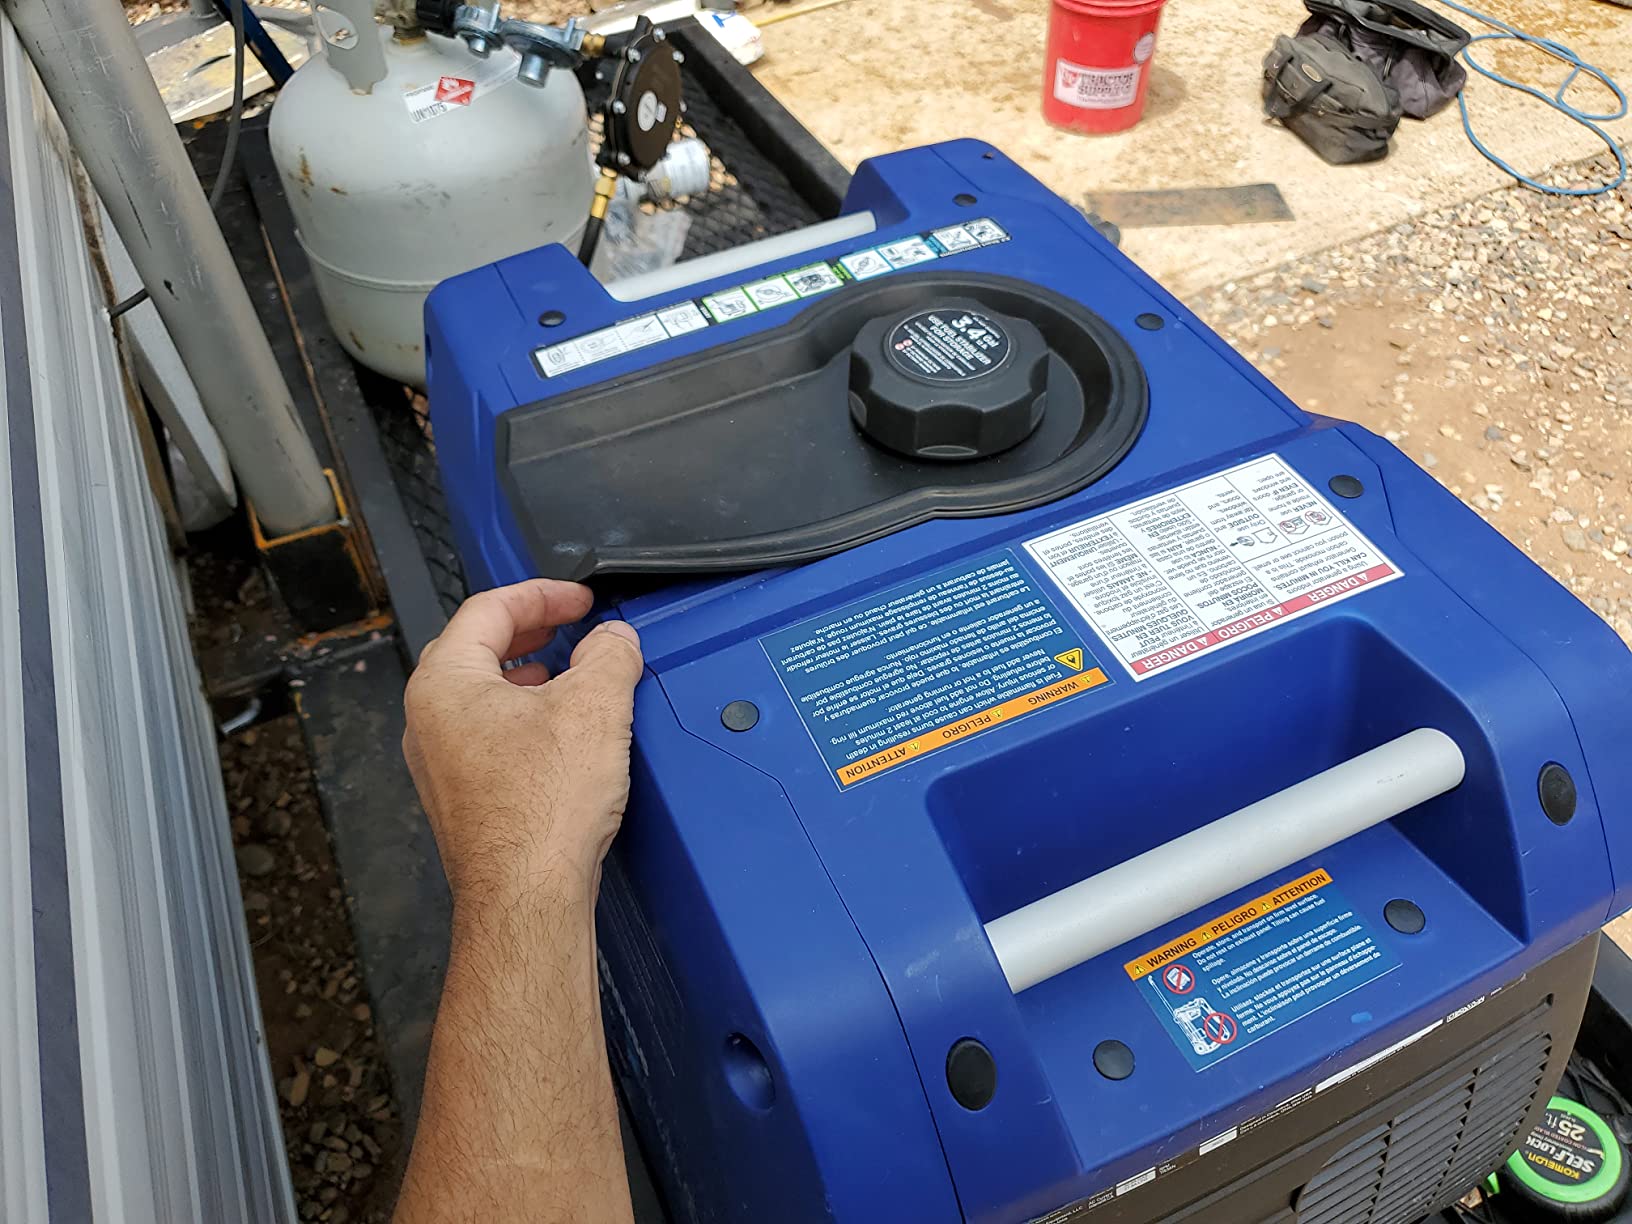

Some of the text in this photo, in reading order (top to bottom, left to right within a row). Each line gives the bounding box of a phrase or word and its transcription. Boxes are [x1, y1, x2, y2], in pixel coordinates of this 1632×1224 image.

[951, 315, 987, 340] 3.4
[928, 314, 944, 327] USE
[940, 324, 958, 338] FUEL
[955, 336, 992, 365] STABILIZER
[930, 325, 945, 338] FOR
[942, 336, 974, 360] STORAGE
[1226, 513, 1259, 528] OUTSIDE
[1333, 558, 1351, 566] KILL
[1349, 552, 1367, 561] CAN
[1316, 564, 1334, 573] YOU
[1272, 574, 1309, 590] MINUTES.
[1306, 576, 1359, 601] DANGER
[1215, 610, 1274, 639] PELIGRO
[1021, 648, 1045, 661] Never
[1140, 640, 1199, 670] DANGER
[990, 663, 1006, 673] fuel
[1005, 657, 1021, 667] add
[1025, 656, 1050, 668] before
[961, 674, 976, 684] hot
[1018, 667, 1046, 681] serious
[1043, 671, 1062, 682] Fuel
[922, 682, 952, 698] running
[948, 688, 964, 698] add
[964, 683, 977, 692] not
[974, 686, 995, 698] Allow
[996, 680, 1036, 700] flammable
[933, 694, 949, 705] fuel
[947, 694, 974, 708] engine
[973, 696, 997, 708] which
[909, 700, 933, 713] above
[957, 705, 973, 714] can
[895, 710, 909, 719] red
[921, 708, 938, 719] cool
[934, 711, 957, 723] cause
[844, 679, 1079, 778] WARNING PELIGRO ATTENTION
[857, 715, 895, 734] maximum
[892, 718, 913, 730] least
[910, 720, 934, 733] burns
[829, 734, 847, 745] ring.
[847, 731, 857, 739] fill
[854, 729, 886, 745] minutes
[877, 729, 911, 746] resulting
[845, 746, 868, 759] death
[1146, 873, 1326, 967] WARNING PELIGRO ATTENTION
[1231, 930, 1242, 938] and
[1241, 918, 1267, 933] transport
[1272, 909, 1285, 917] firm
[1283, 902, 1298, 912] level
[1205, 952, 1216, 960] not
[1215, 946, 1227, 955] rest
[1234, 932, 1256, 946] exhaust
[1271, 916, 1290, 927] Tilting
[1298, 903, 1315, 914] cause
[1313, 898, 1325, 906] fuel
[1557, 1120, 1586, 1142] 25
